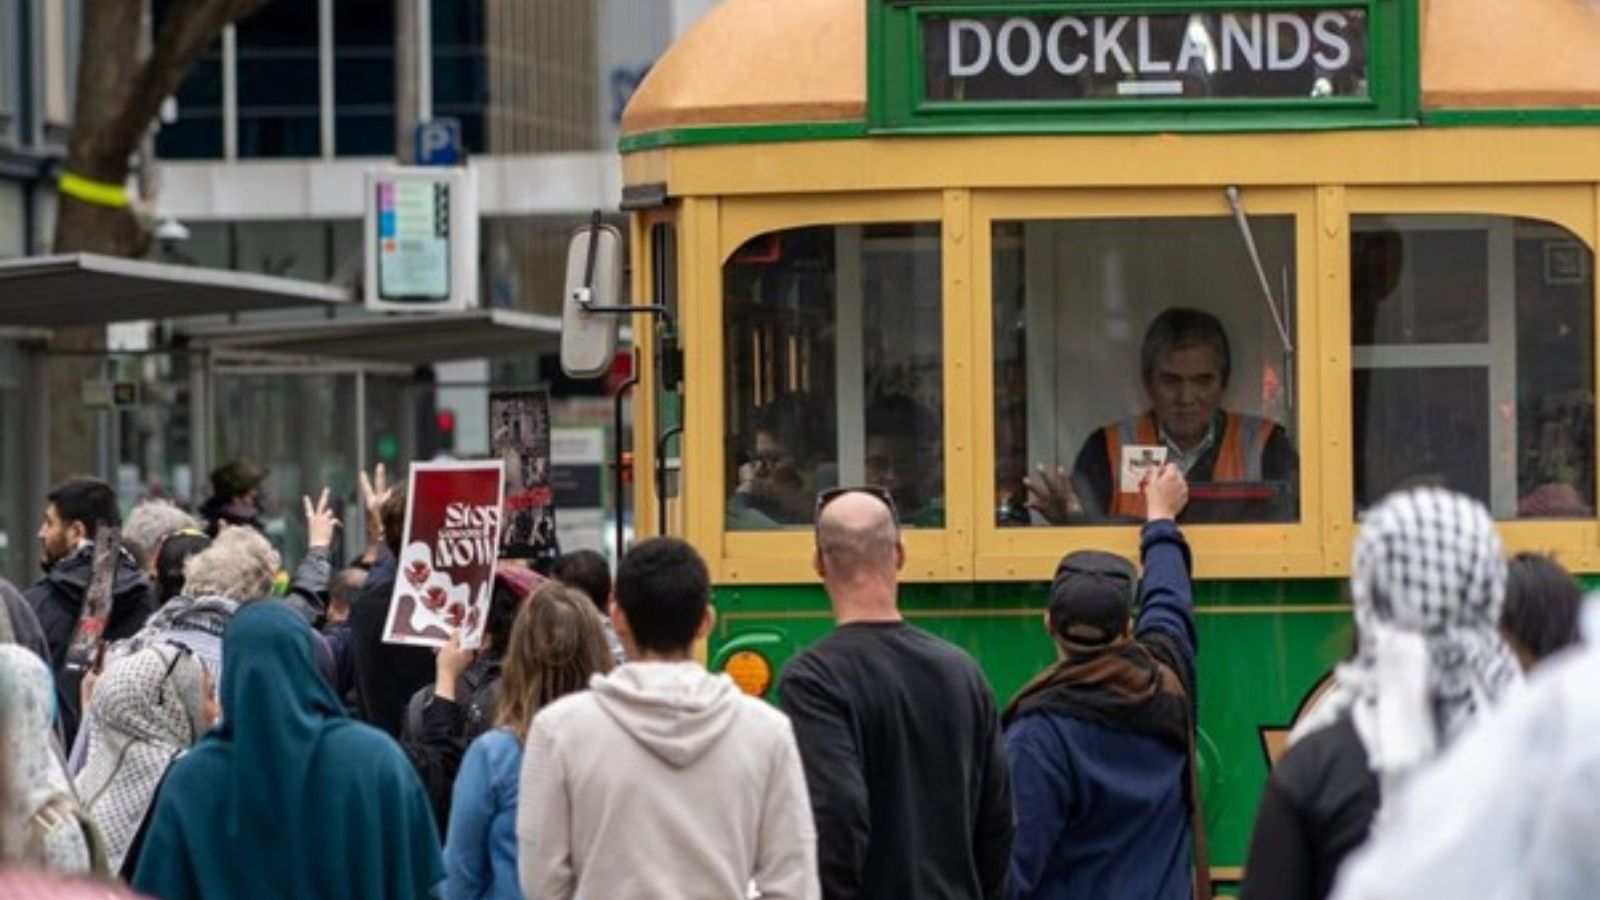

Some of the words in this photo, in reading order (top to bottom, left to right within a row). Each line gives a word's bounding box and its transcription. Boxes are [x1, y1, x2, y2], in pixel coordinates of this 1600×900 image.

[949, 12, 1351, 76] DOCKLANDS
[422, 127, 449, 161] P
[446, 502, 499, 535] Stop
